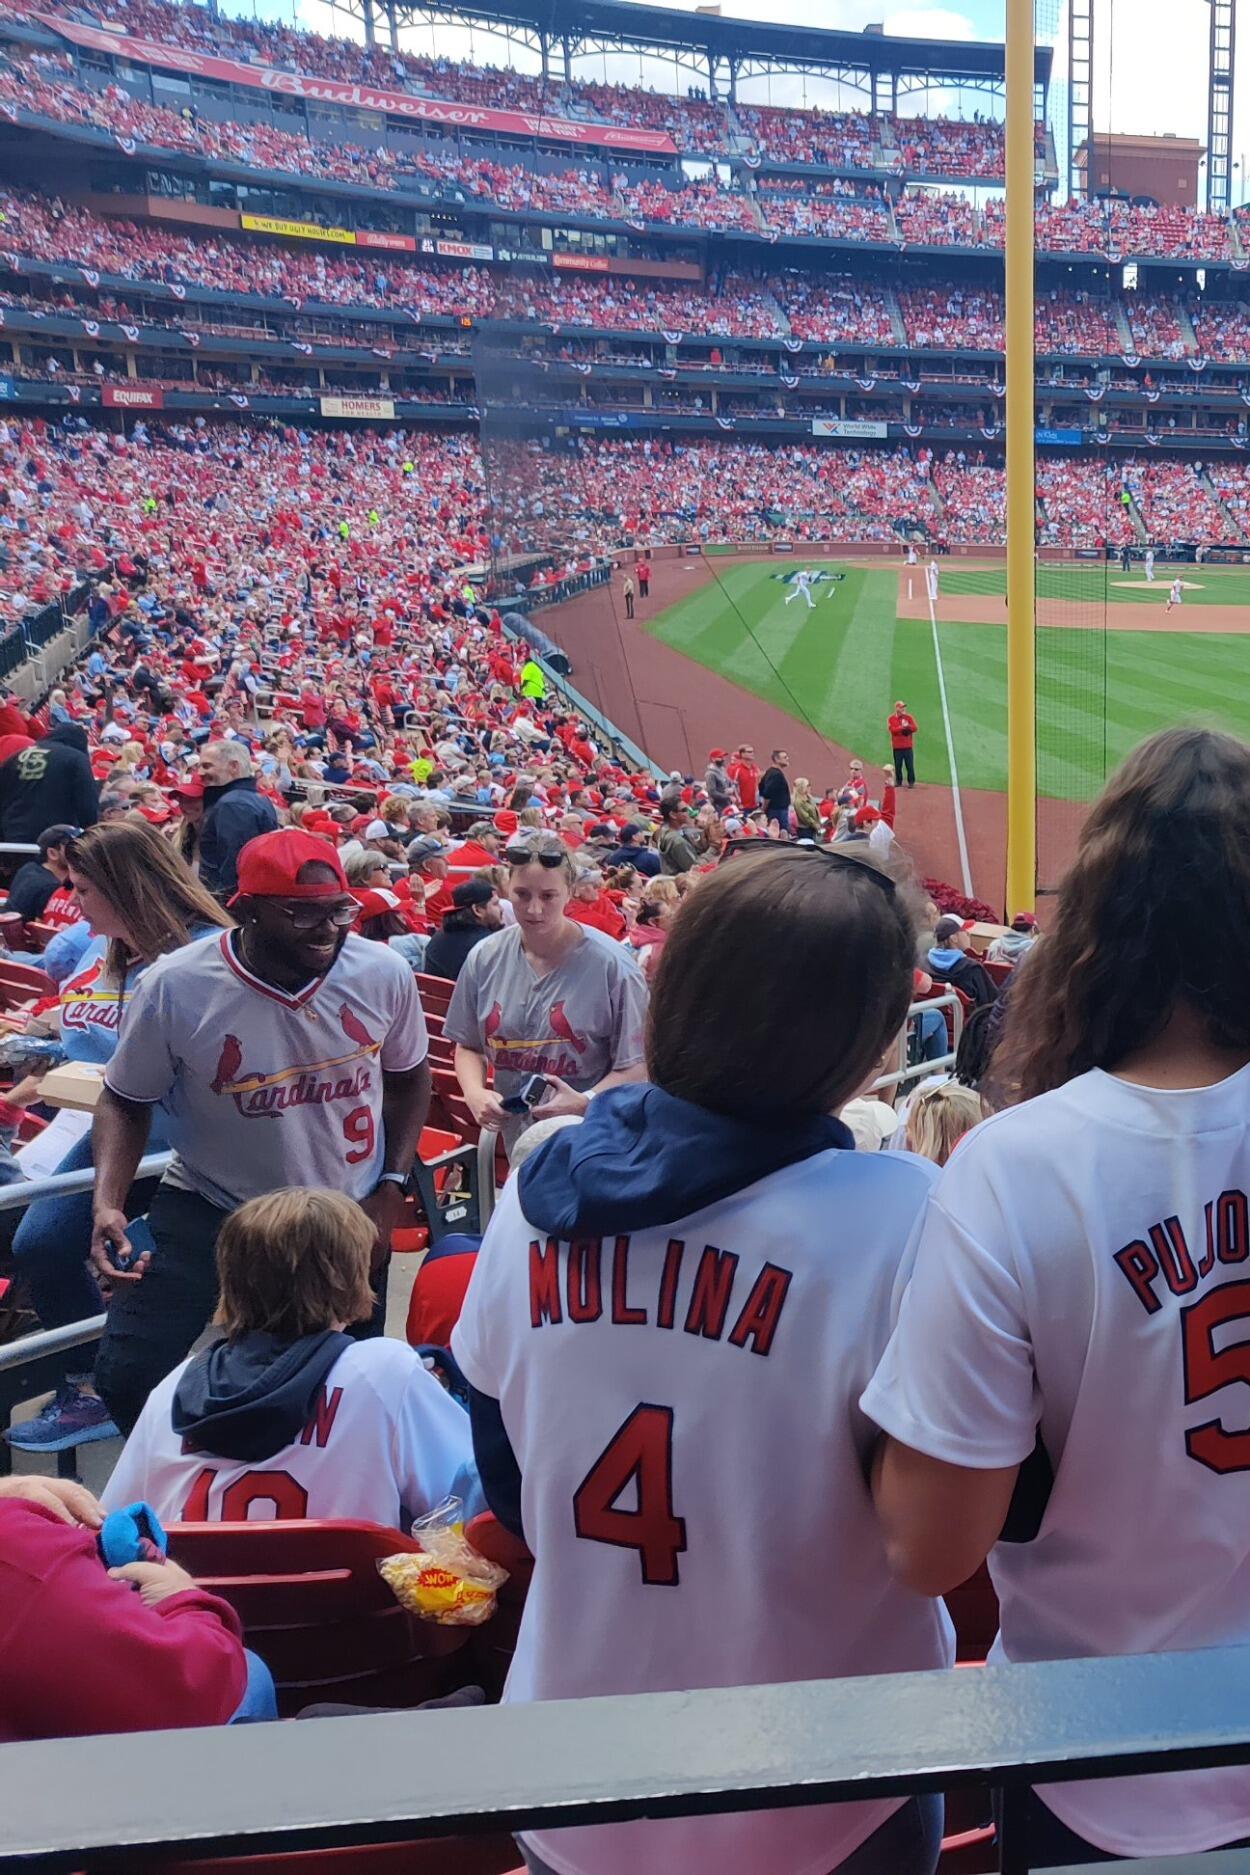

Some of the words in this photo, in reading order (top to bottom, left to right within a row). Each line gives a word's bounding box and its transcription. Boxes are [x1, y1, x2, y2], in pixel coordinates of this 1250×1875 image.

[260, 71, 488, 123] Budweiser
[438, 242, 473, 256] KMOX
[113, 390, 152, 406] EQUIFAX
[342, 401, 380, 410] HOMERS
[233, 1066, 371, 1119] Cardinals
[343, 1104, 375, 1164] 9
[529, 1235, 793, 1356] MOLINA
[572, 1402, 687, 1586] 4
